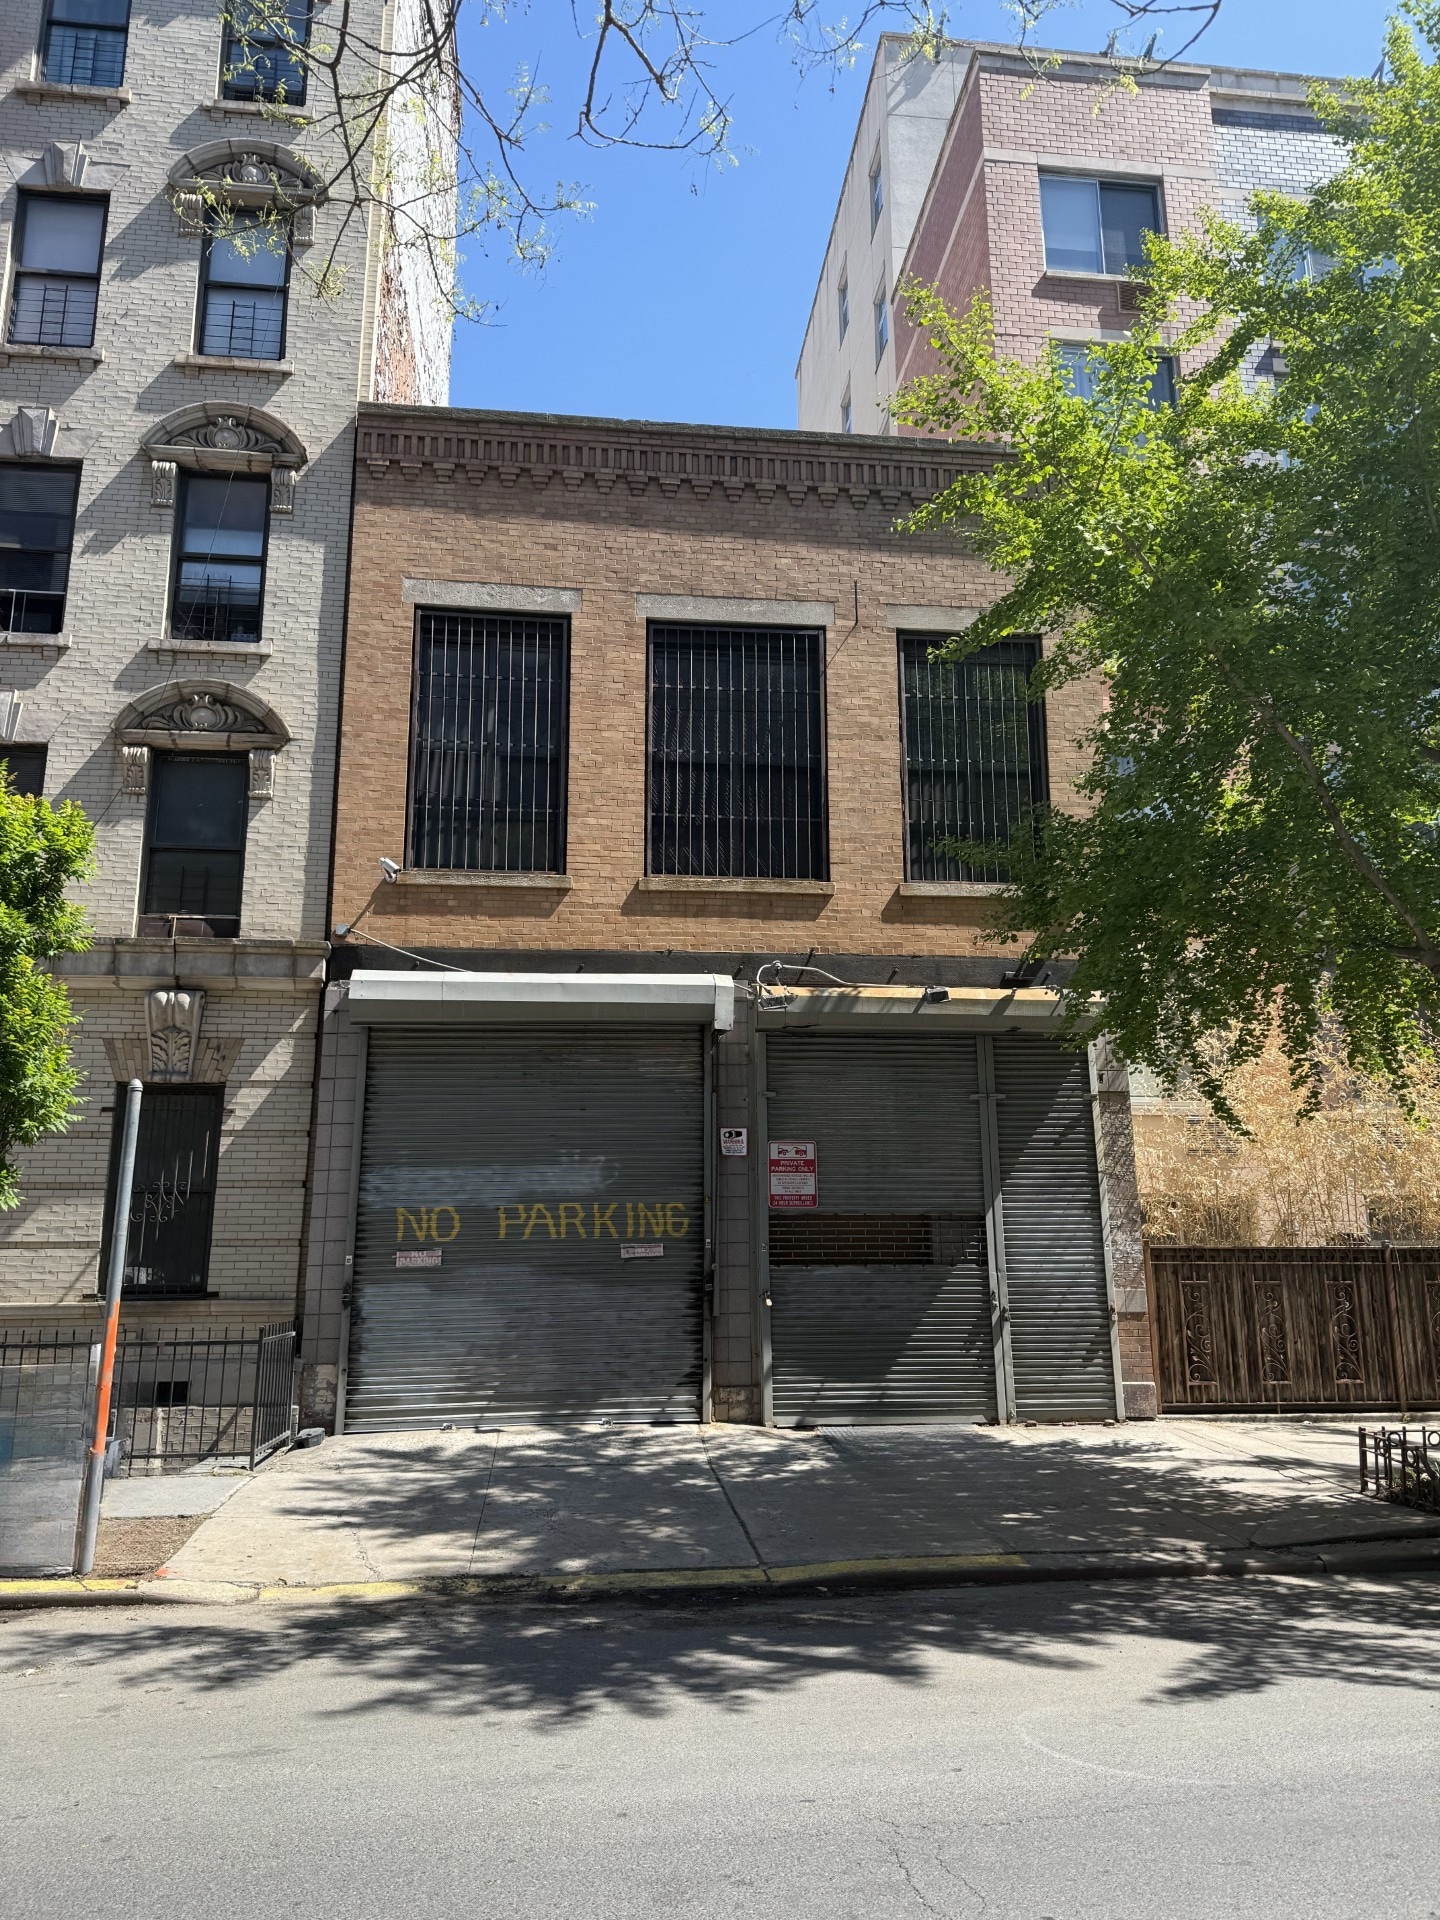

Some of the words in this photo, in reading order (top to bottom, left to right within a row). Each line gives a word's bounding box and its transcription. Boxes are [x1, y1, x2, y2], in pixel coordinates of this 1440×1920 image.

[396, 1205, 461, 1242] NO
[498, 1202, 690, 1240] PARKING
[400, 1256, 438, 1266] PARKING
